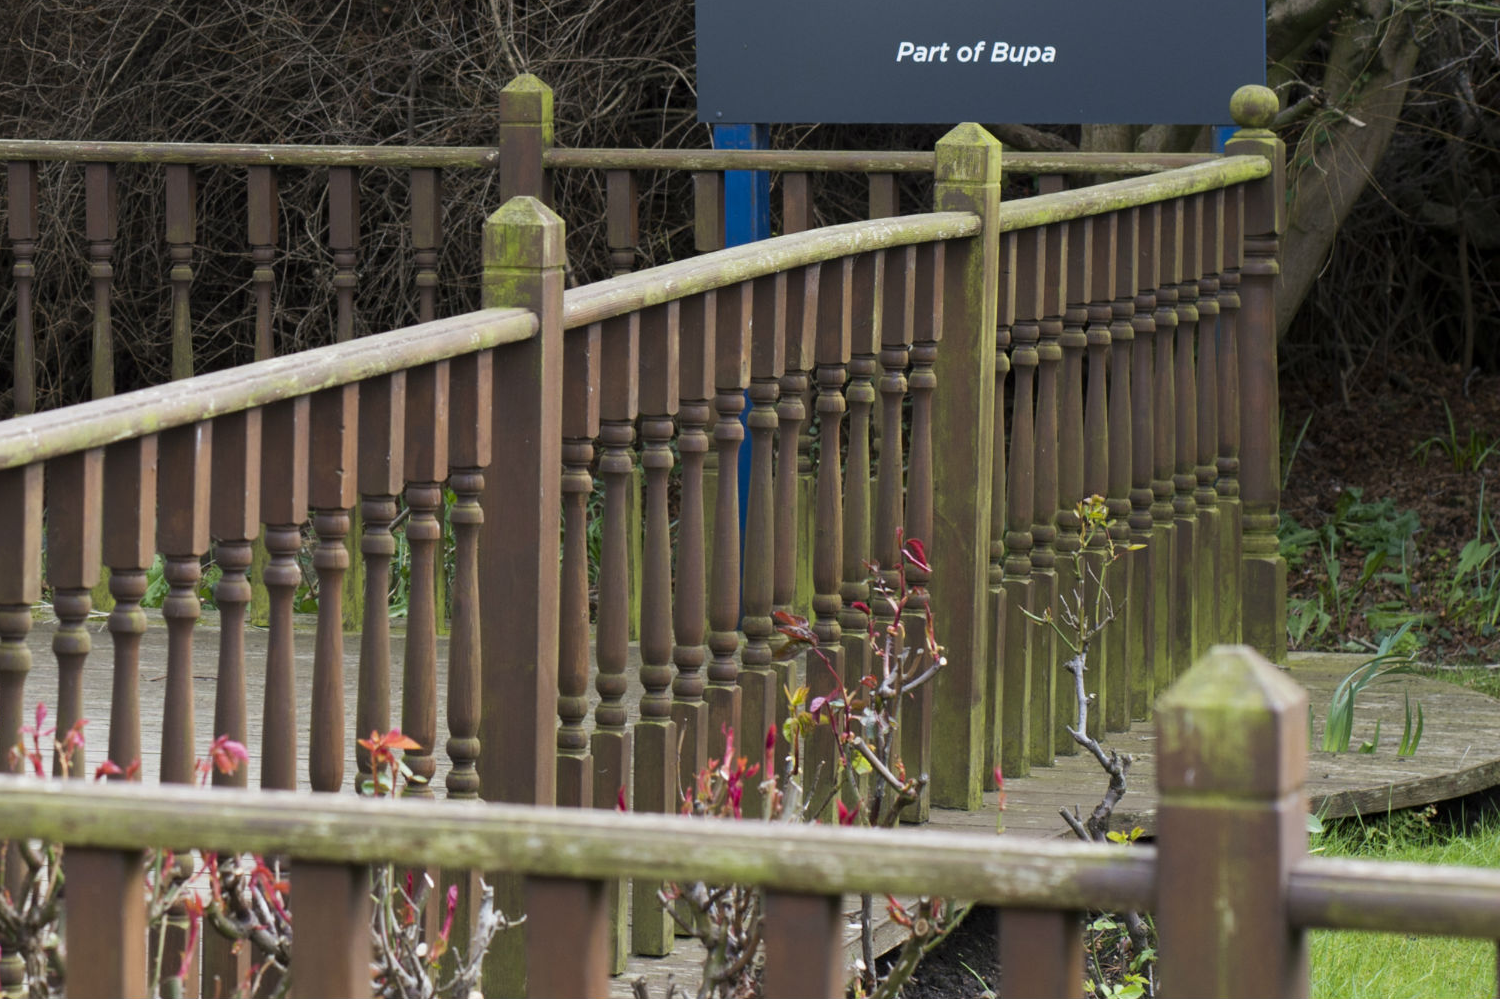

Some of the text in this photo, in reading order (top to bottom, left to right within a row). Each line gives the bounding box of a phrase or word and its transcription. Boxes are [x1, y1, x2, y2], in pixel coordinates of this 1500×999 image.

[895, 40, 1057, 67] Part of Bupa
